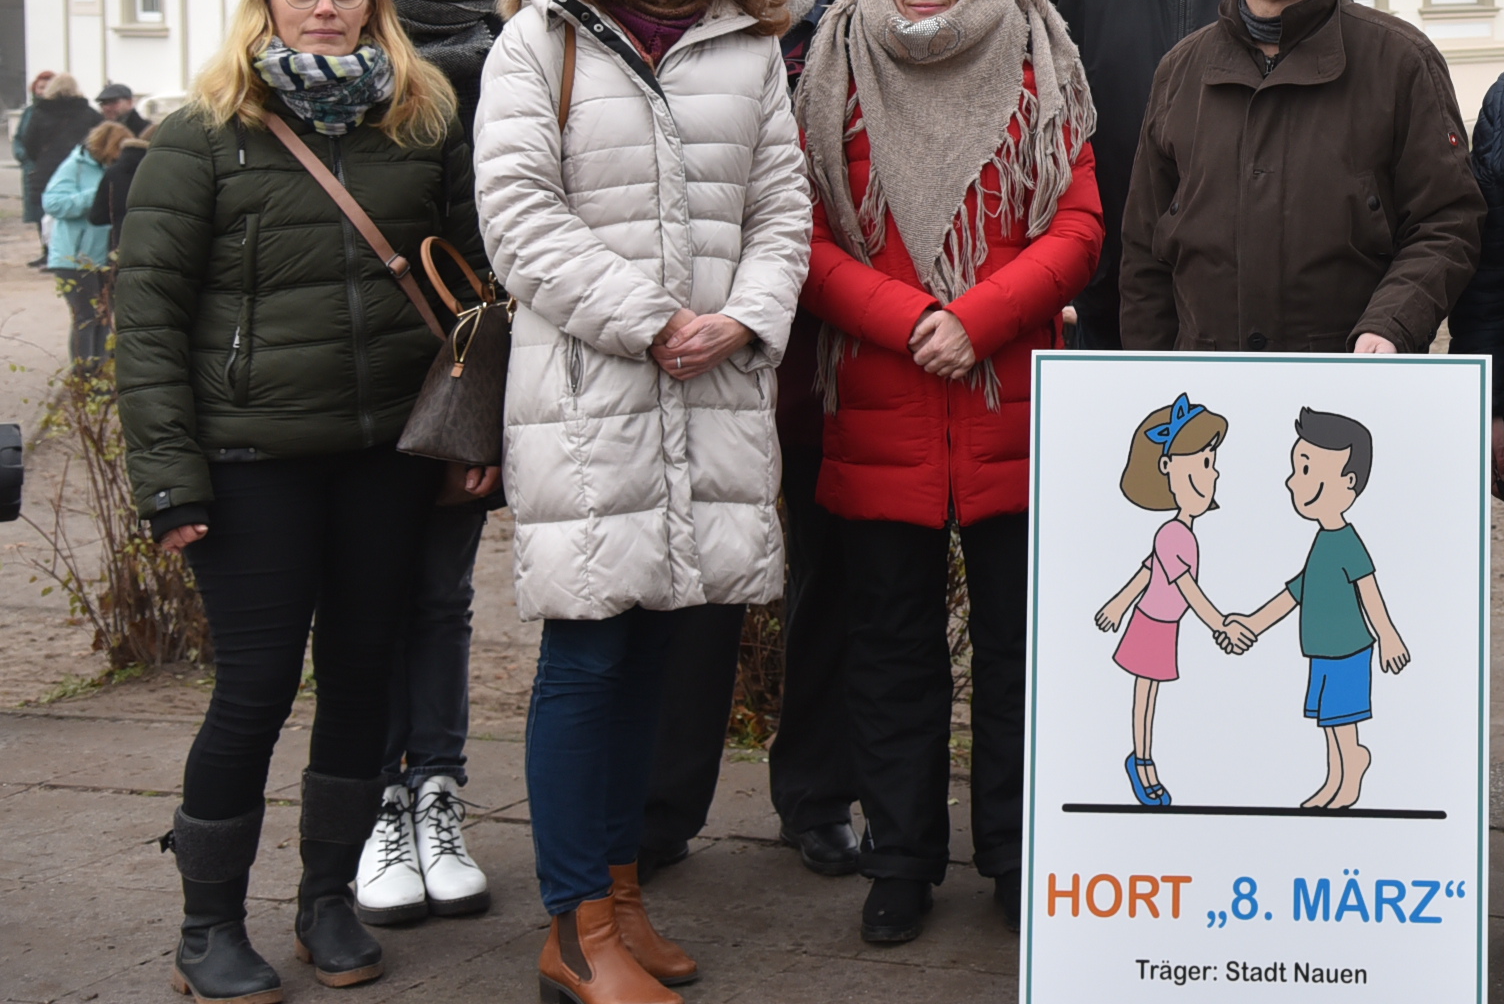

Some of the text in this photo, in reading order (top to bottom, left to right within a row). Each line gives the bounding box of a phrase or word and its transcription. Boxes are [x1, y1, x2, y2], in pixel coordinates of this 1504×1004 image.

[1048, 868, 1466, 929] HORT „8. MÄRZ“
[1135, 959, 1368, 986] Träger: Stadt Nauen
